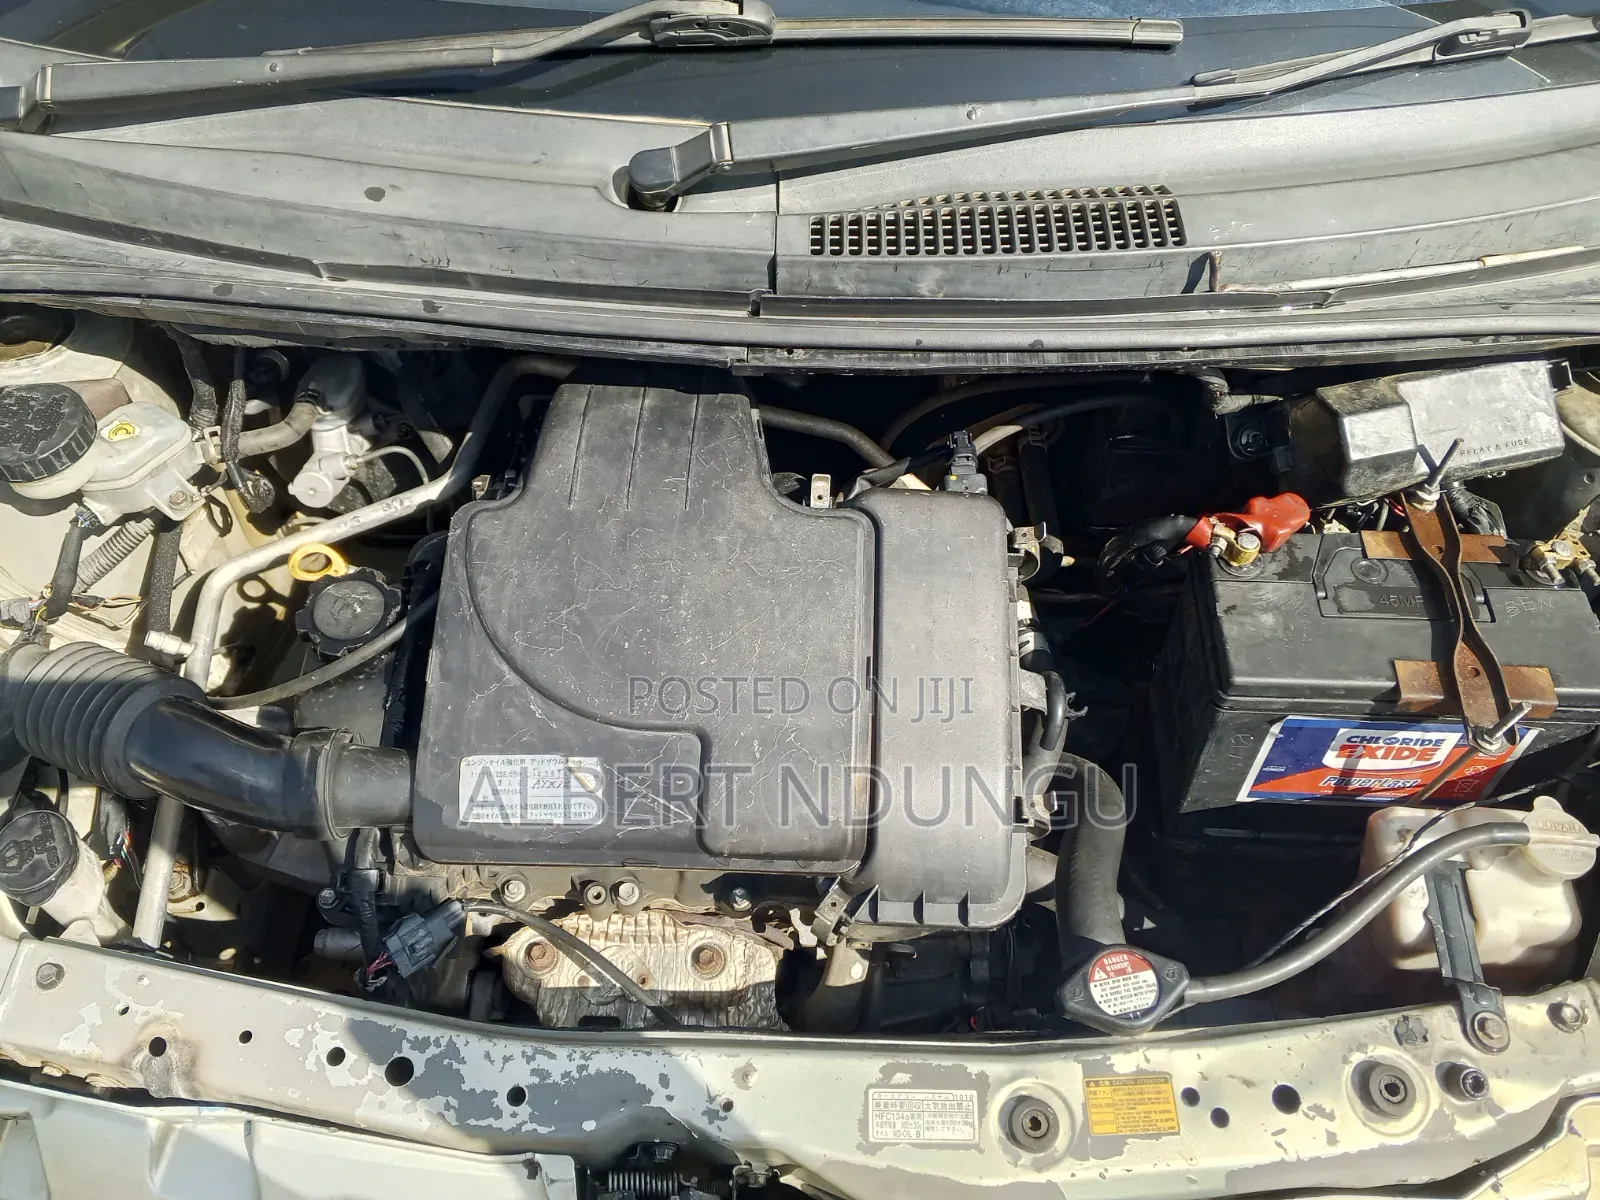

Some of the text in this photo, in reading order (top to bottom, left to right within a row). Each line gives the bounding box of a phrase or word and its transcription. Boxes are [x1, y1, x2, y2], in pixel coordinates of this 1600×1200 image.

[1460, 445, 1491, 456] RELAY
[1505, 438, 1529, 448] FUSE
[1346, 735, 1447, 747] CHLORIDE
[1335, 744, 1439, 761] EXIDE
[1103, 954, 1129, 966] DANGER
